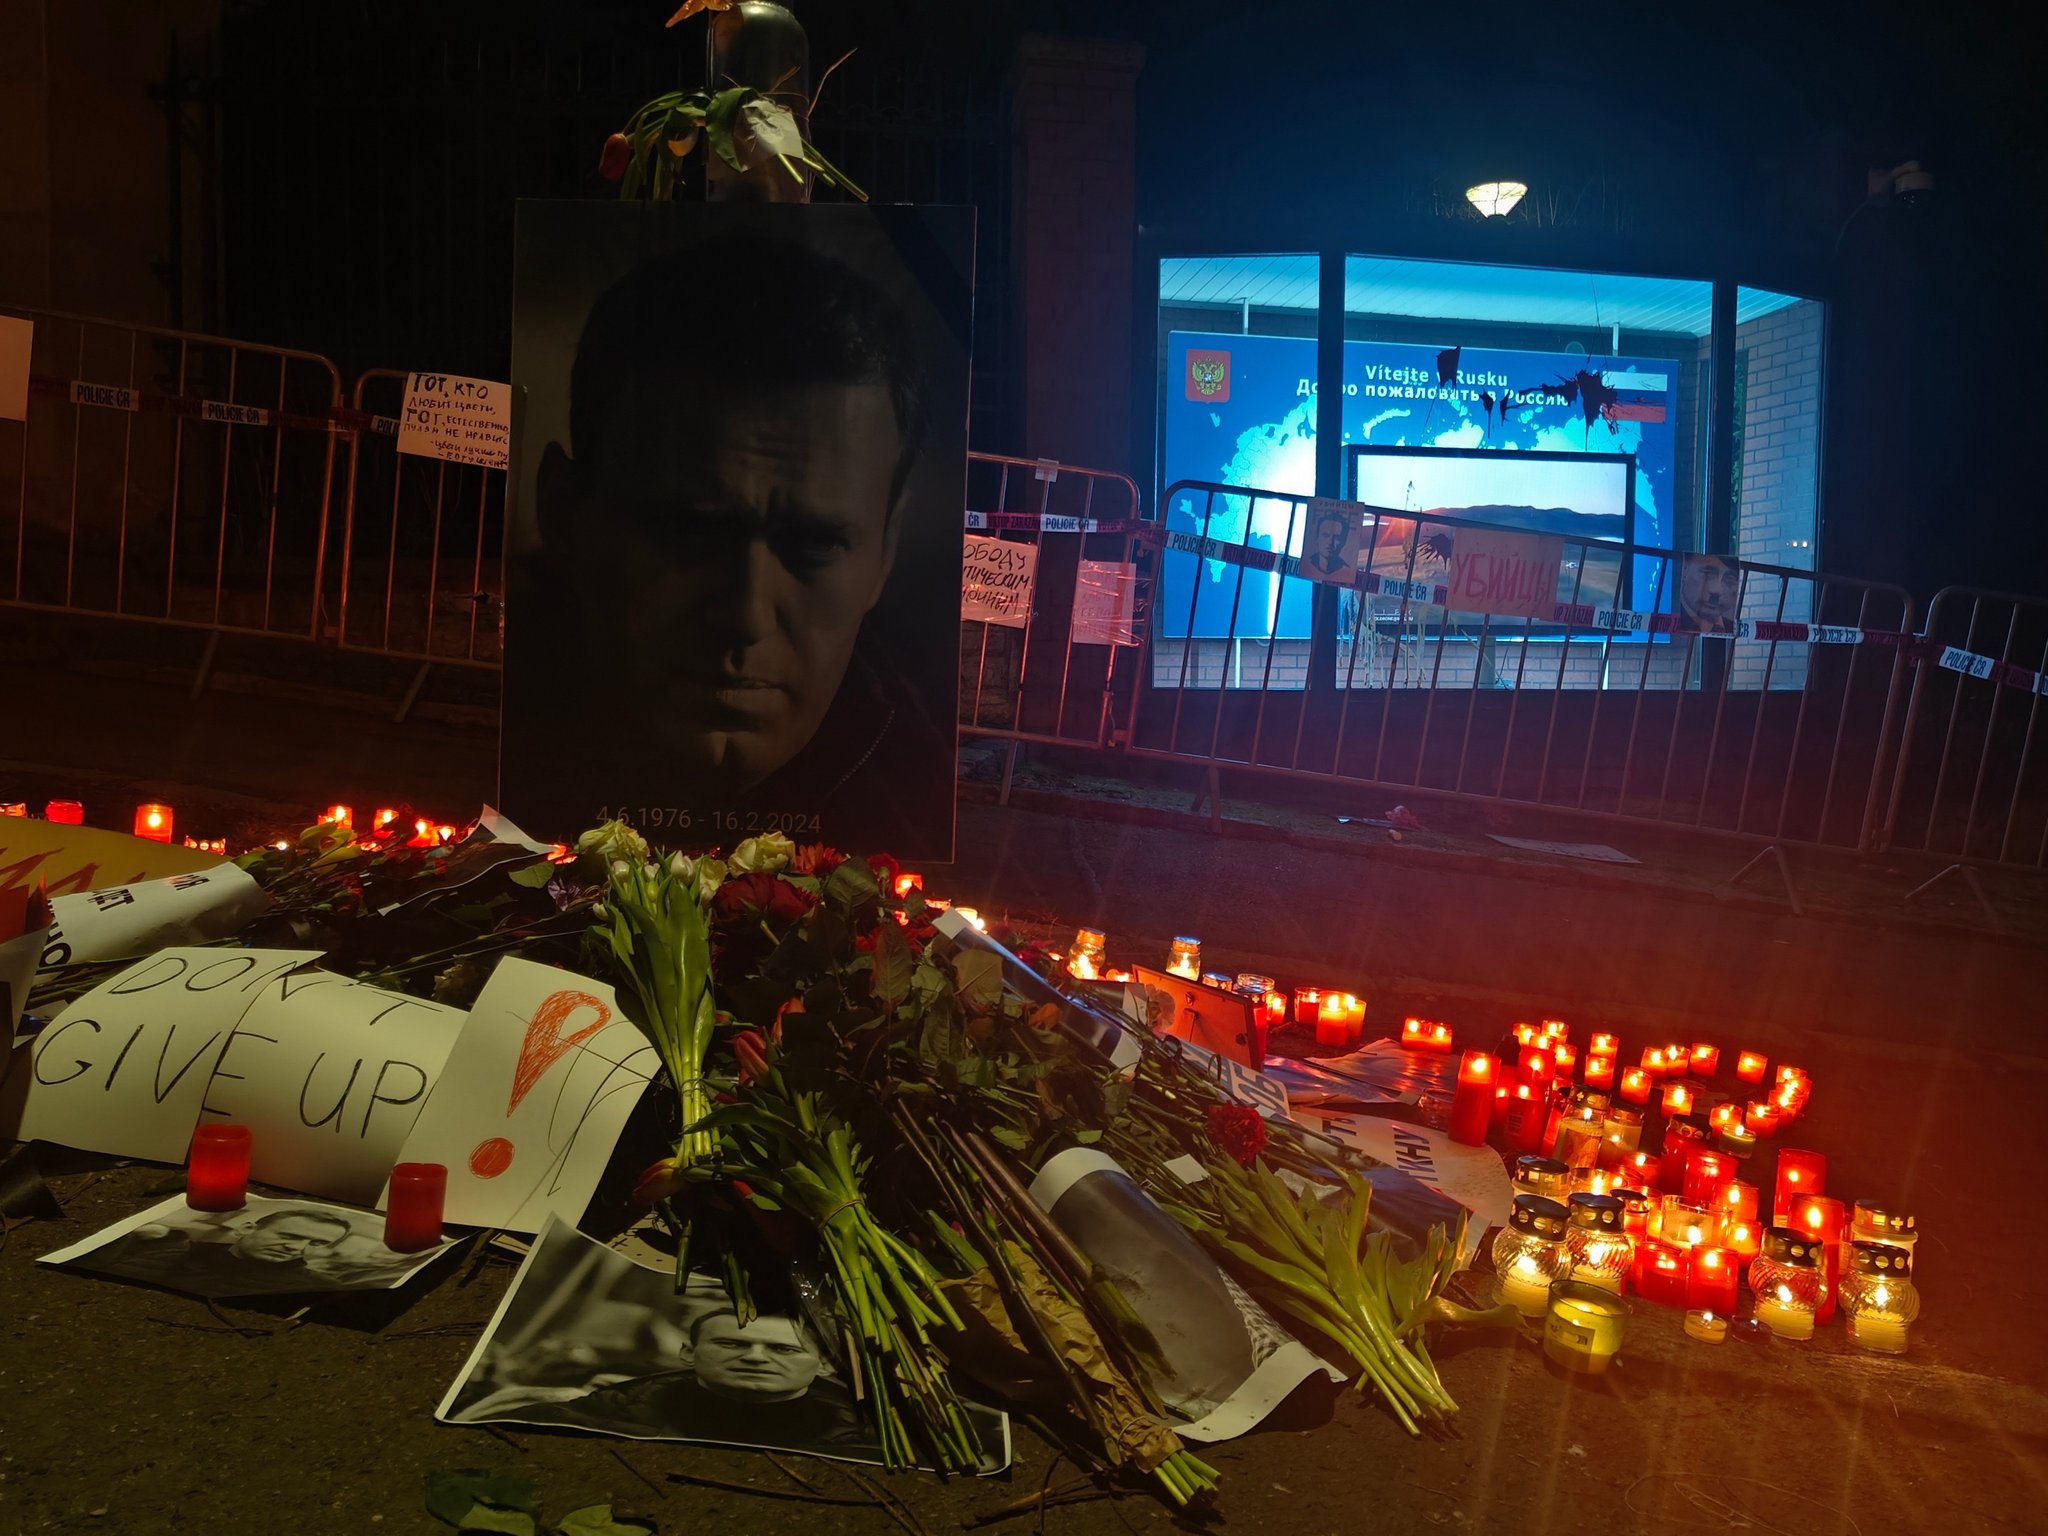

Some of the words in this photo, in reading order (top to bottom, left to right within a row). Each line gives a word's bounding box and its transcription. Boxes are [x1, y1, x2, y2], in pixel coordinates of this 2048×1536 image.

[1366, 364, 1429, 384] Vítejte
[1456, 370, 1508, 387] Rusku
[77, 384, 114, 405] POLICIE
[454, 381, 489, 399] КТО
[1365, 384, 1480, 402] пожаловать
[409, 396, 452, 409] ЛЮБИТ
[208, 403, 244, 422] POLICIE
[445, 427, 460, 438] НЕ
[968, 512, 980, 527] ČR
[1045, 517, 1076, 530] POLICIE
[963, 543, 1026, 571] ОБОДУ
[963, 565, 1031, 590] ТИЧЕСКИМ
[1453, 551, 1554, 602] УБИЙЦЫ
[1415, 582, 1428, 601] ČR
[1812, 627, 1844, 642] POLICIE
[1973, 656, 1987, 676] ČR
[711, 810, 822, 833] 16.2.2024
[34, 1018, 278, 1117] GIVE
[299, 1051, 428, 1139] UP
